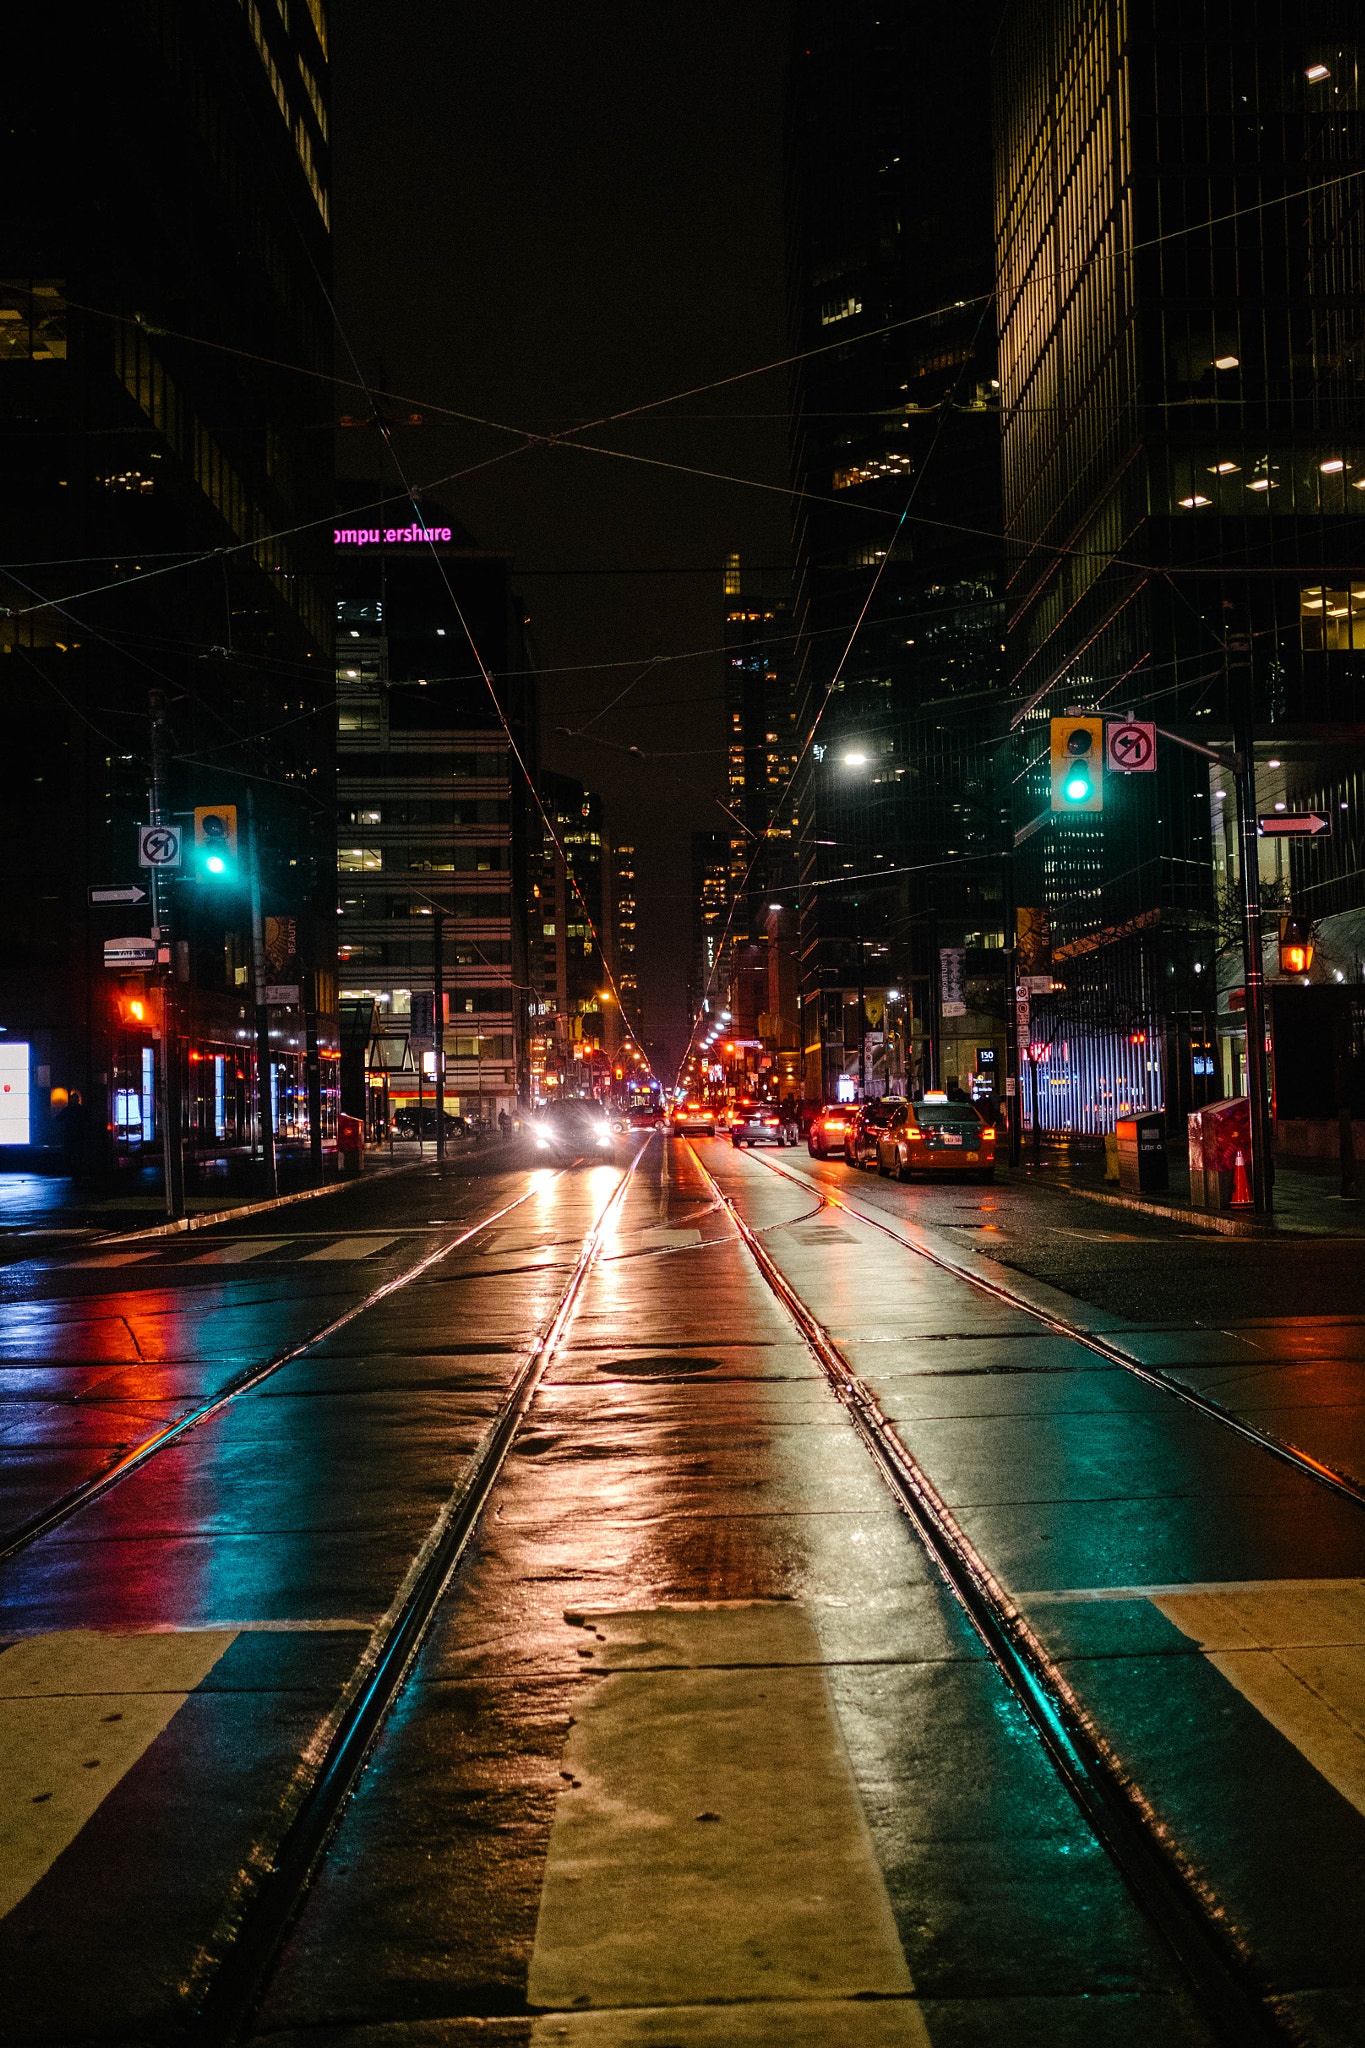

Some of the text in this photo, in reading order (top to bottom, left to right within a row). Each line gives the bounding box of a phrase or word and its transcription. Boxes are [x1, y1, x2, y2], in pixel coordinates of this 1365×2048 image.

[287, 918, 297, 955] BEAUTY
[1291, 949, 1303, 971] 4
[939, 951, 949, 1001] OPPORTUNITY
[131, 1001, 143, 1020] 4
[980, 1051, 994, 1059] 150
[1140, 1143, 1155, 1151] Litter
